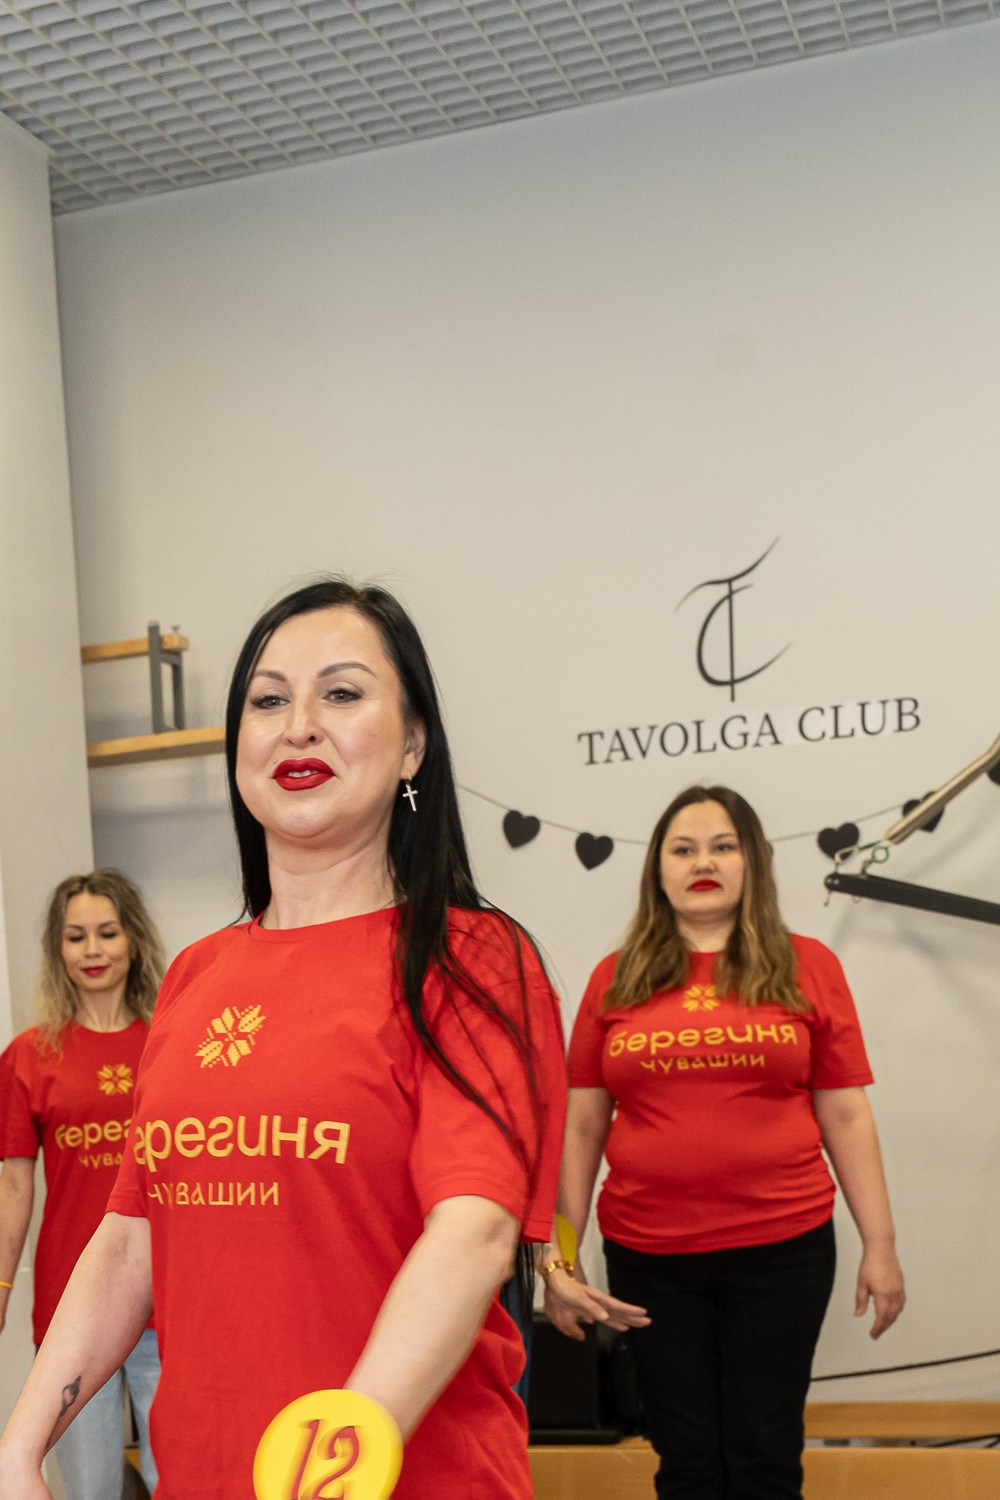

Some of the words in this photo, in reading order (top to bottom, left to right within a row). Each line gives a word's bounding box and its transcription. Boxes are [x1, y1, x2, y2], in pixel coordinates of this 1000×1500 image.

[577, 711, 783, 766] TAVOLGA
[798, 697, 921, 742] CLUB
[609, 1023, 798, 1057] берегиня
[133, 1114, 351, 1173] ерегиня
